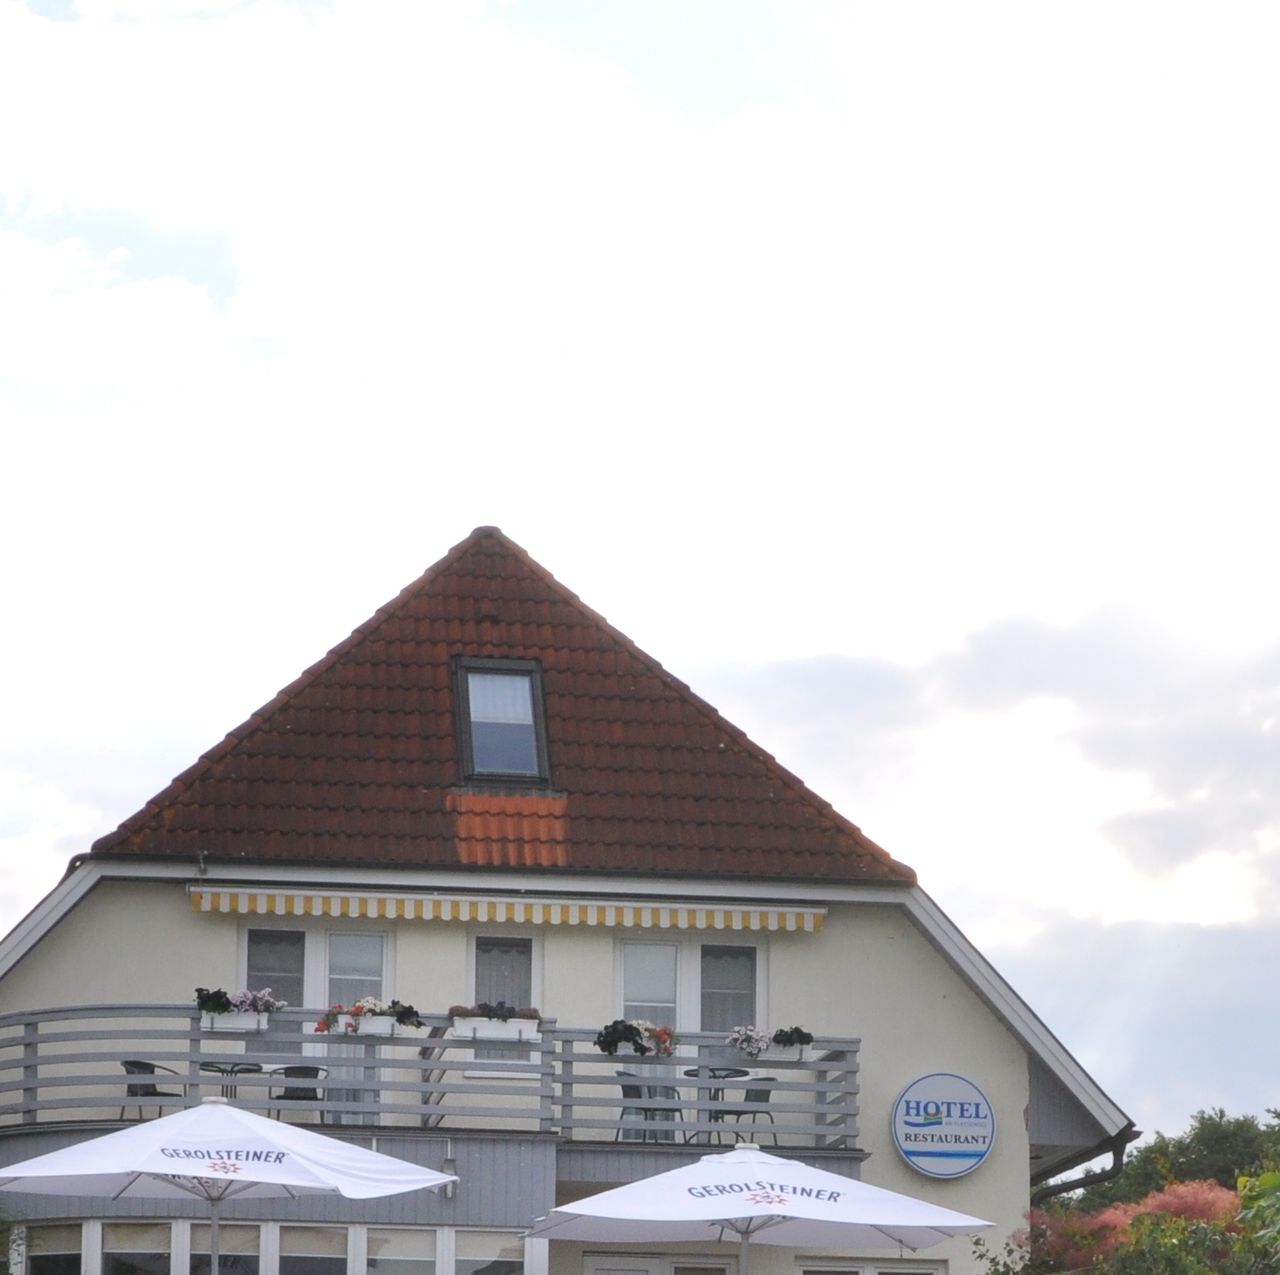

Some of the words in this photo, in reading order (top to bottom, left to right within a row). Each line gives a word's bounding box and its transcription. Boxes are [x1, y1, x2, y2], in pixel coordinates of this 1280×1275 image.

[904, 1100, 988, 1119] HOTEL
[904, 1133, 988, 1145] RESTAURANT
[161, 1148, 286, 1164] GEROLSTEINER
[688, 1181, 841, 1202] GEROLSTEINER
